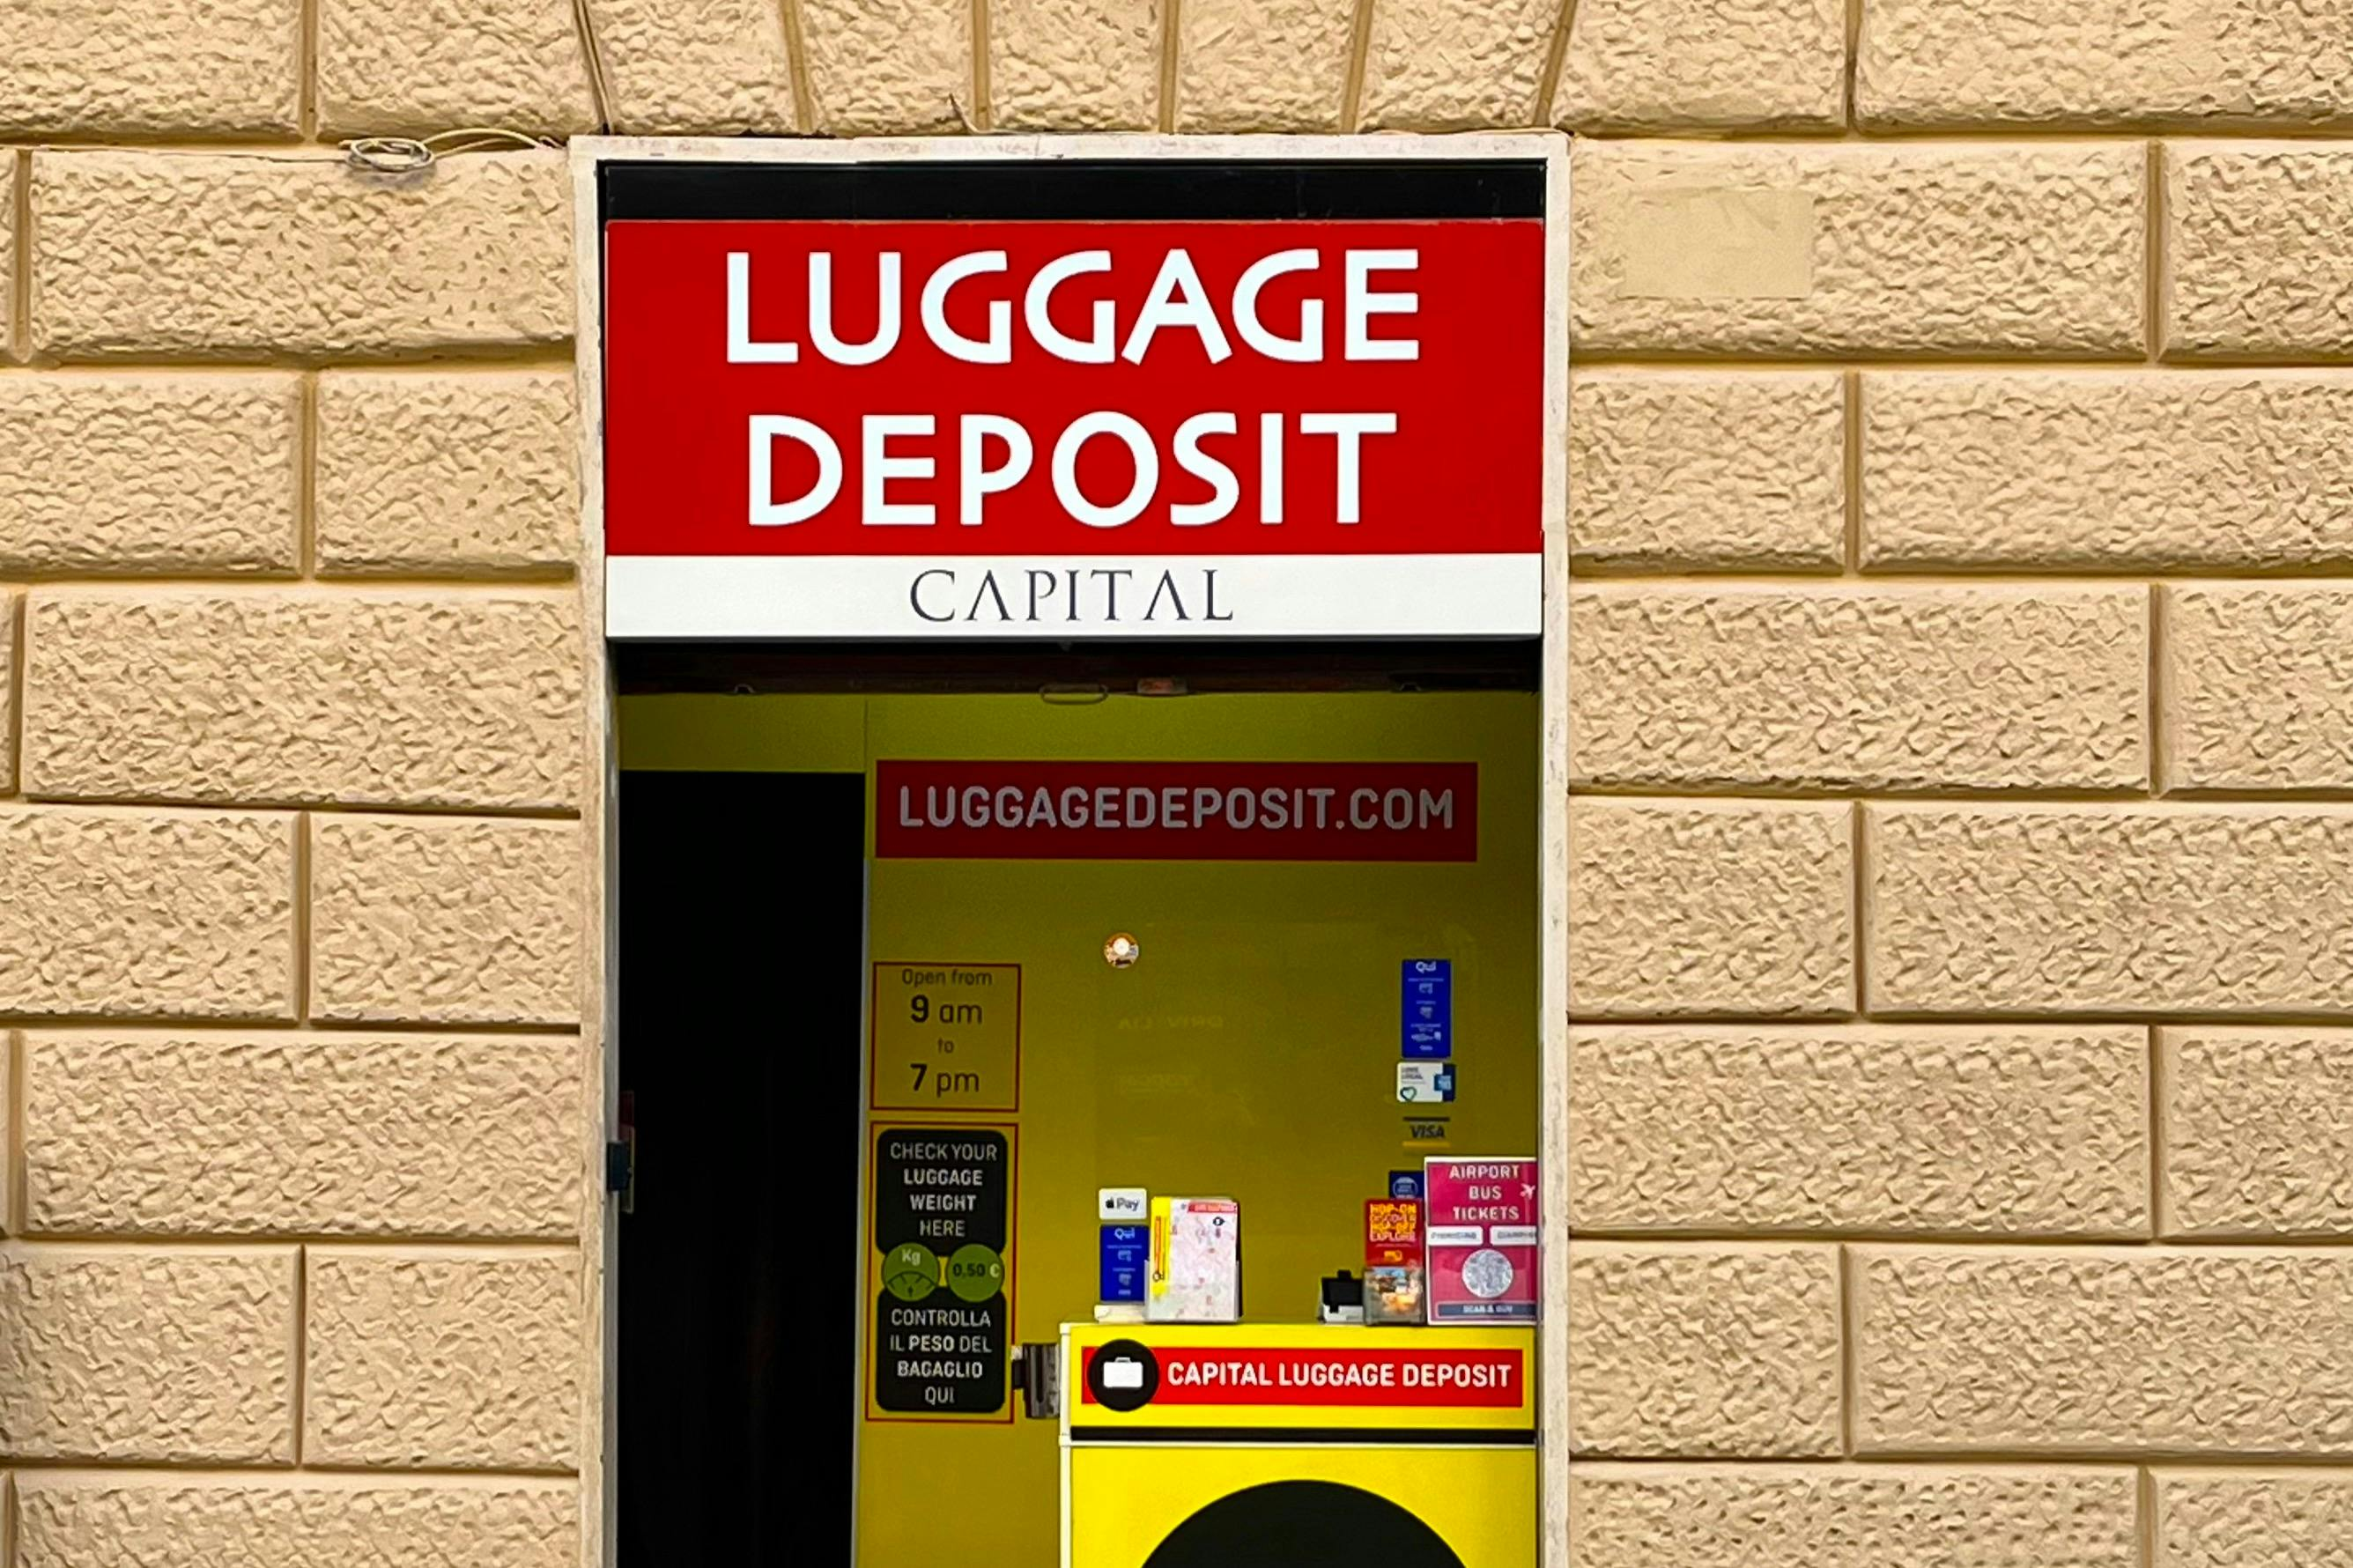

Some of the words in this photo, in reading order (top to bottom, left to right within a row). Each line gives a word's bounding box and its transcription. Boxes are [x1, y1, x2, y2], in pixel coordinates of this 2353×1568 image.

[727, 248, 1420, 365] LUGGAGE
[748, 411, 1397, 528] DEPOSIT
[909, 568, 1234, 623] CAPITAL
[899, 785, 1454, 832] LUGGAGEDEPOSIT.COM
[901, 968, 946, 987] Open
[951, 968, 992, 985] from
[910, 994, 929, 1023] 9
[939, 1003, 982, 1024] am
[937, 1038, 954, 1054] to
[910, 1063, 928, 1091] 7
[936, 1071, 979, 1098] pm
[1411, 1126, 1445, 1139] VISA
[890, 1142, 948, 1160] CHECK
[951, 1143, 997, 1160] YOUR
[903, 1168, 983, 1186] LUGGAGE
[1449, 1164, 1521, 1180] AIRPORT
[909, 1194, 976, 1211] WEIGHT
[1469, 1186, 1503, 1202] BUS
[1116, 1198, 1140, 1212] Pay
[1452, 1206, 1521, 1222] TICKETS
[919, 1219, 966, 1237] HERE
[901, 1248, 921, 1266] Kg
[891, 1308, 991, 1327] CONTROLLA
[890, 1334, 905, 1351] IL
[908, 1334, 955, 1352] PESO
[959, 1335, 992, 1353] DEL
[897, 1360, 983, 1378] BAGAGLIO
[1167, 1362, 1272, 1386] CAPITAL
[1279, 1362, 1395, 1387] LUGGAGE
[1402, 1363, 1512, 1388] DEPOSIT
[924, 1387, 955, 1405] QUI
